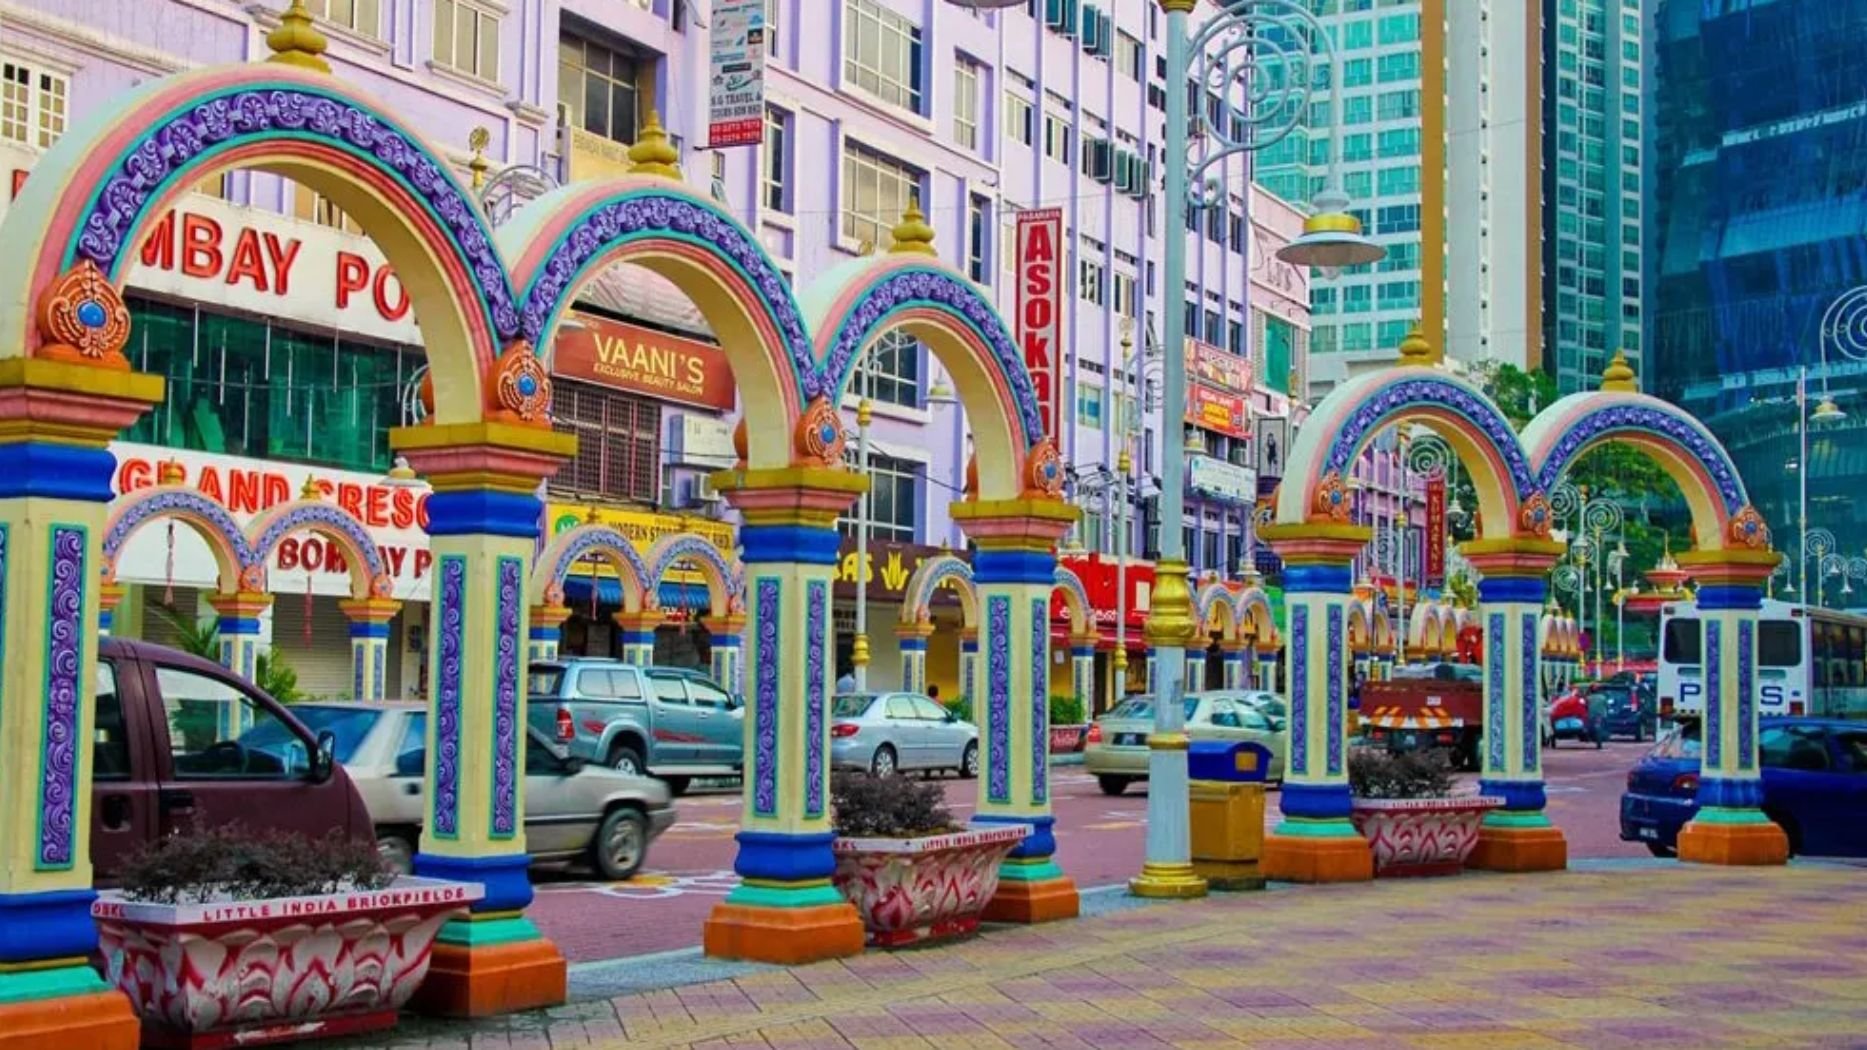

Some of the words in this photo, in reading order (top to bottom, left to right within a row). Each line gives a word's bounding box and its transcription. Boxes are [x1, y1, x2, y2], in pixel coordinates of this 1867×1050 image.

[593, 333, 705, 384] VAANI'S
[642, 371, 675, 390] BEAUTY
[277, 538, 407, 579] BOMY
[203, 905, 271, 921] LITTLE
[283, 901, 337, 916] INDIA
